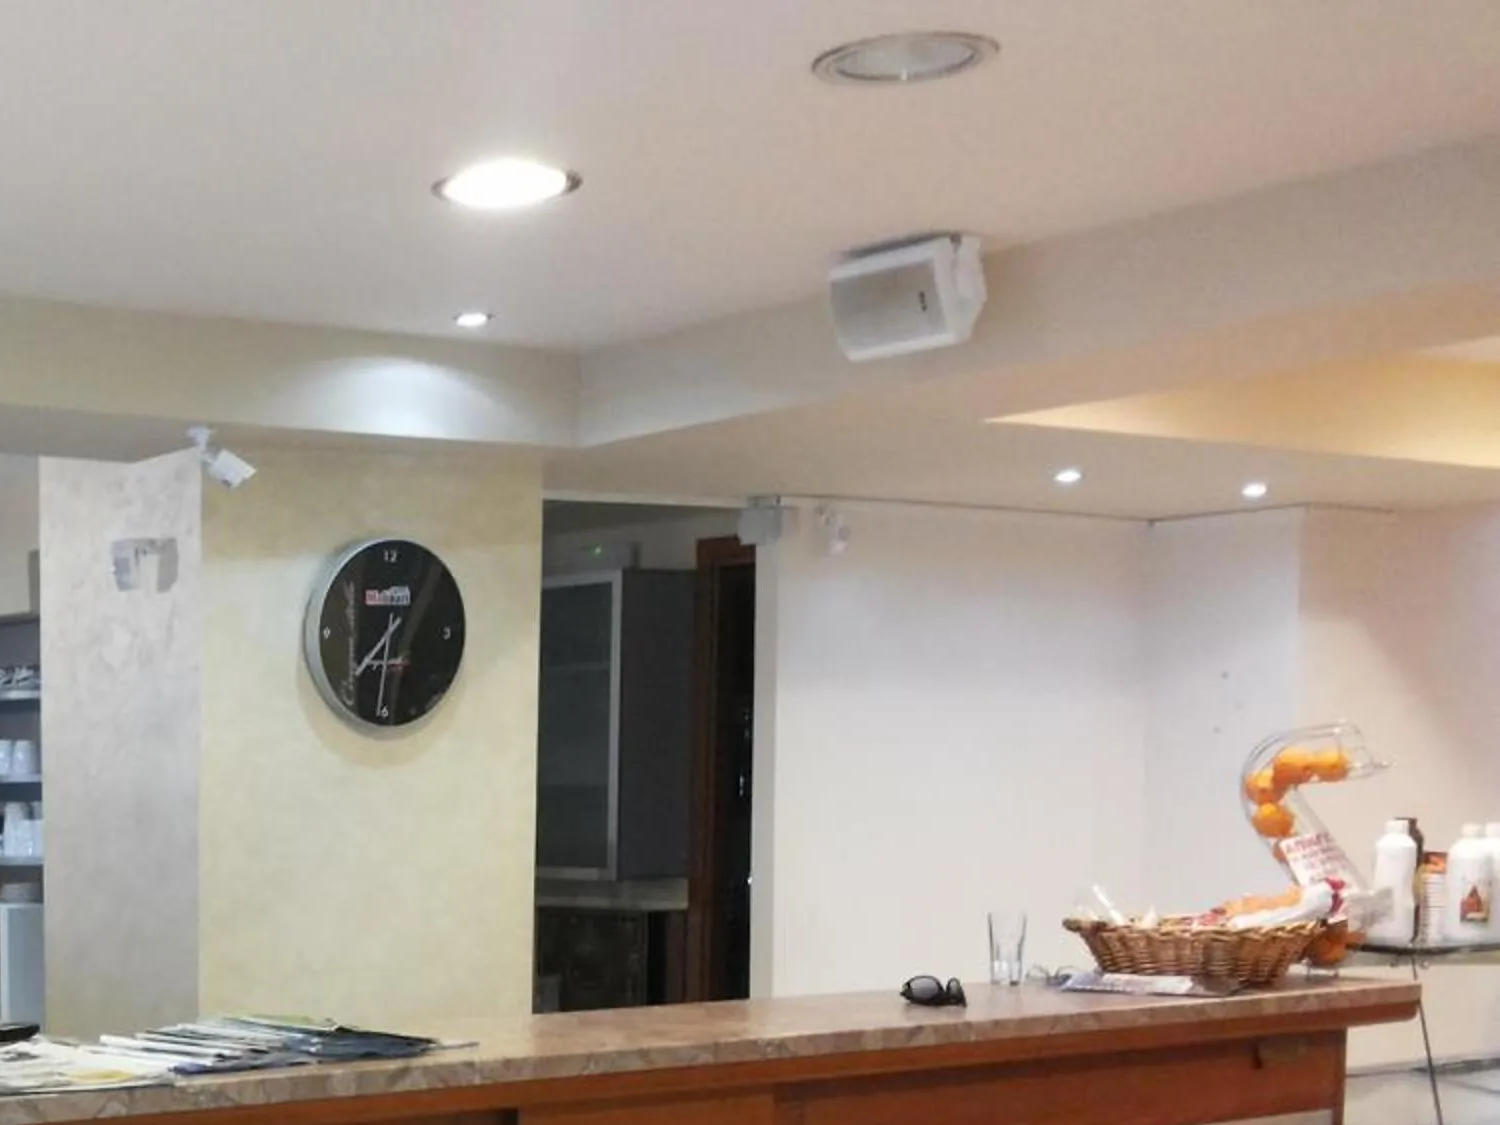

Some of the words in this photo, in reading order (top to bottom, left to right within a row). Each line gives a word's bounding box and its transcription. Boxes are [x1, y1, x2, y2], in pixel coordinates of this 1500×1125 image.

[384, 551, 397, 562] 12
[443, 627, 451, 640] 3
[381, 706, 389, 718] 6
